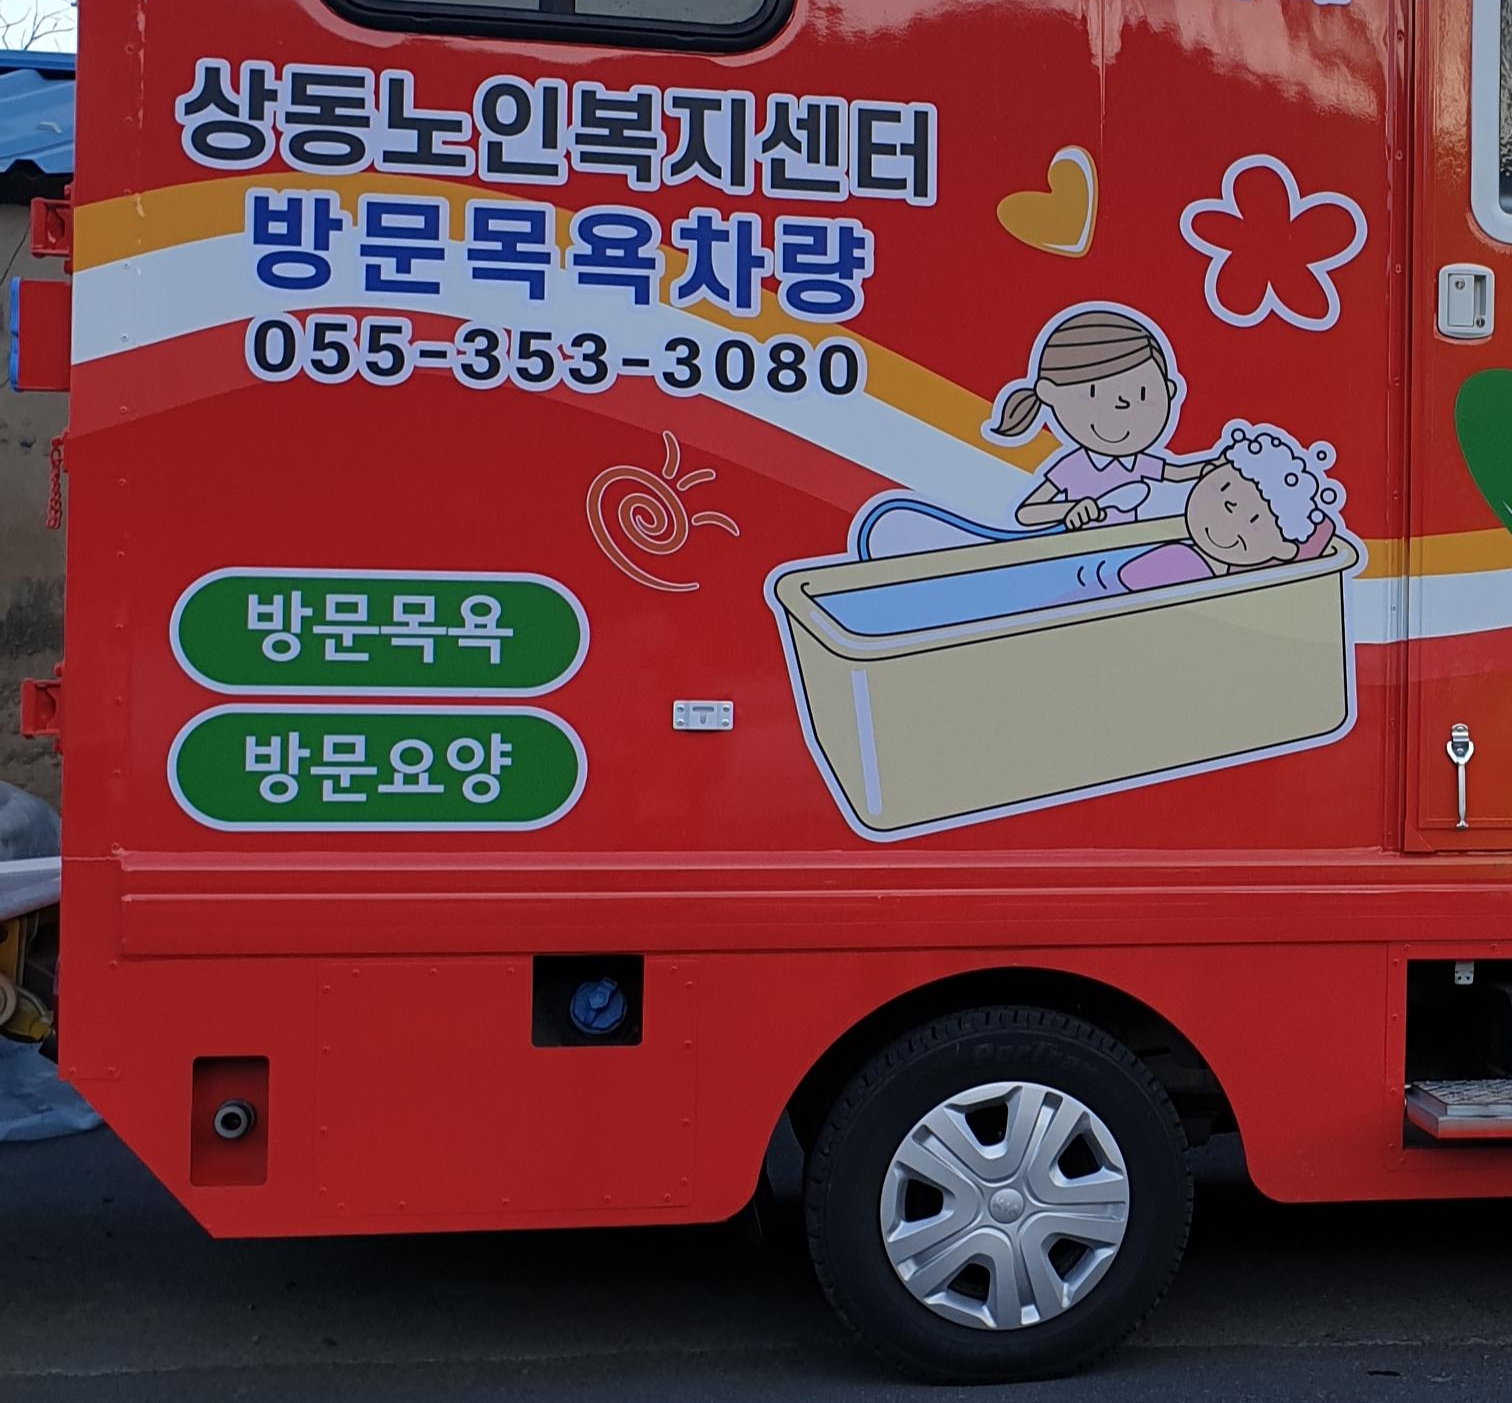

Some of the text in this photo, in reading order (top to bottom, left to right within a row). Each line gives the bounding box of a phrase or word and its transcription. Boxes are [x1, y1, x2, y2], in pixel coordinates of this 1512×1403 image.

[183, 65, 930, 199] 상동노인복지센터
[252, 196, 866, 316] 방문목욕차량
[253, 319, 860, 394] 055-353-3080
[246, 590, 514, 664] 방문목욕
[244, 731, 513, 804] 방문요양
